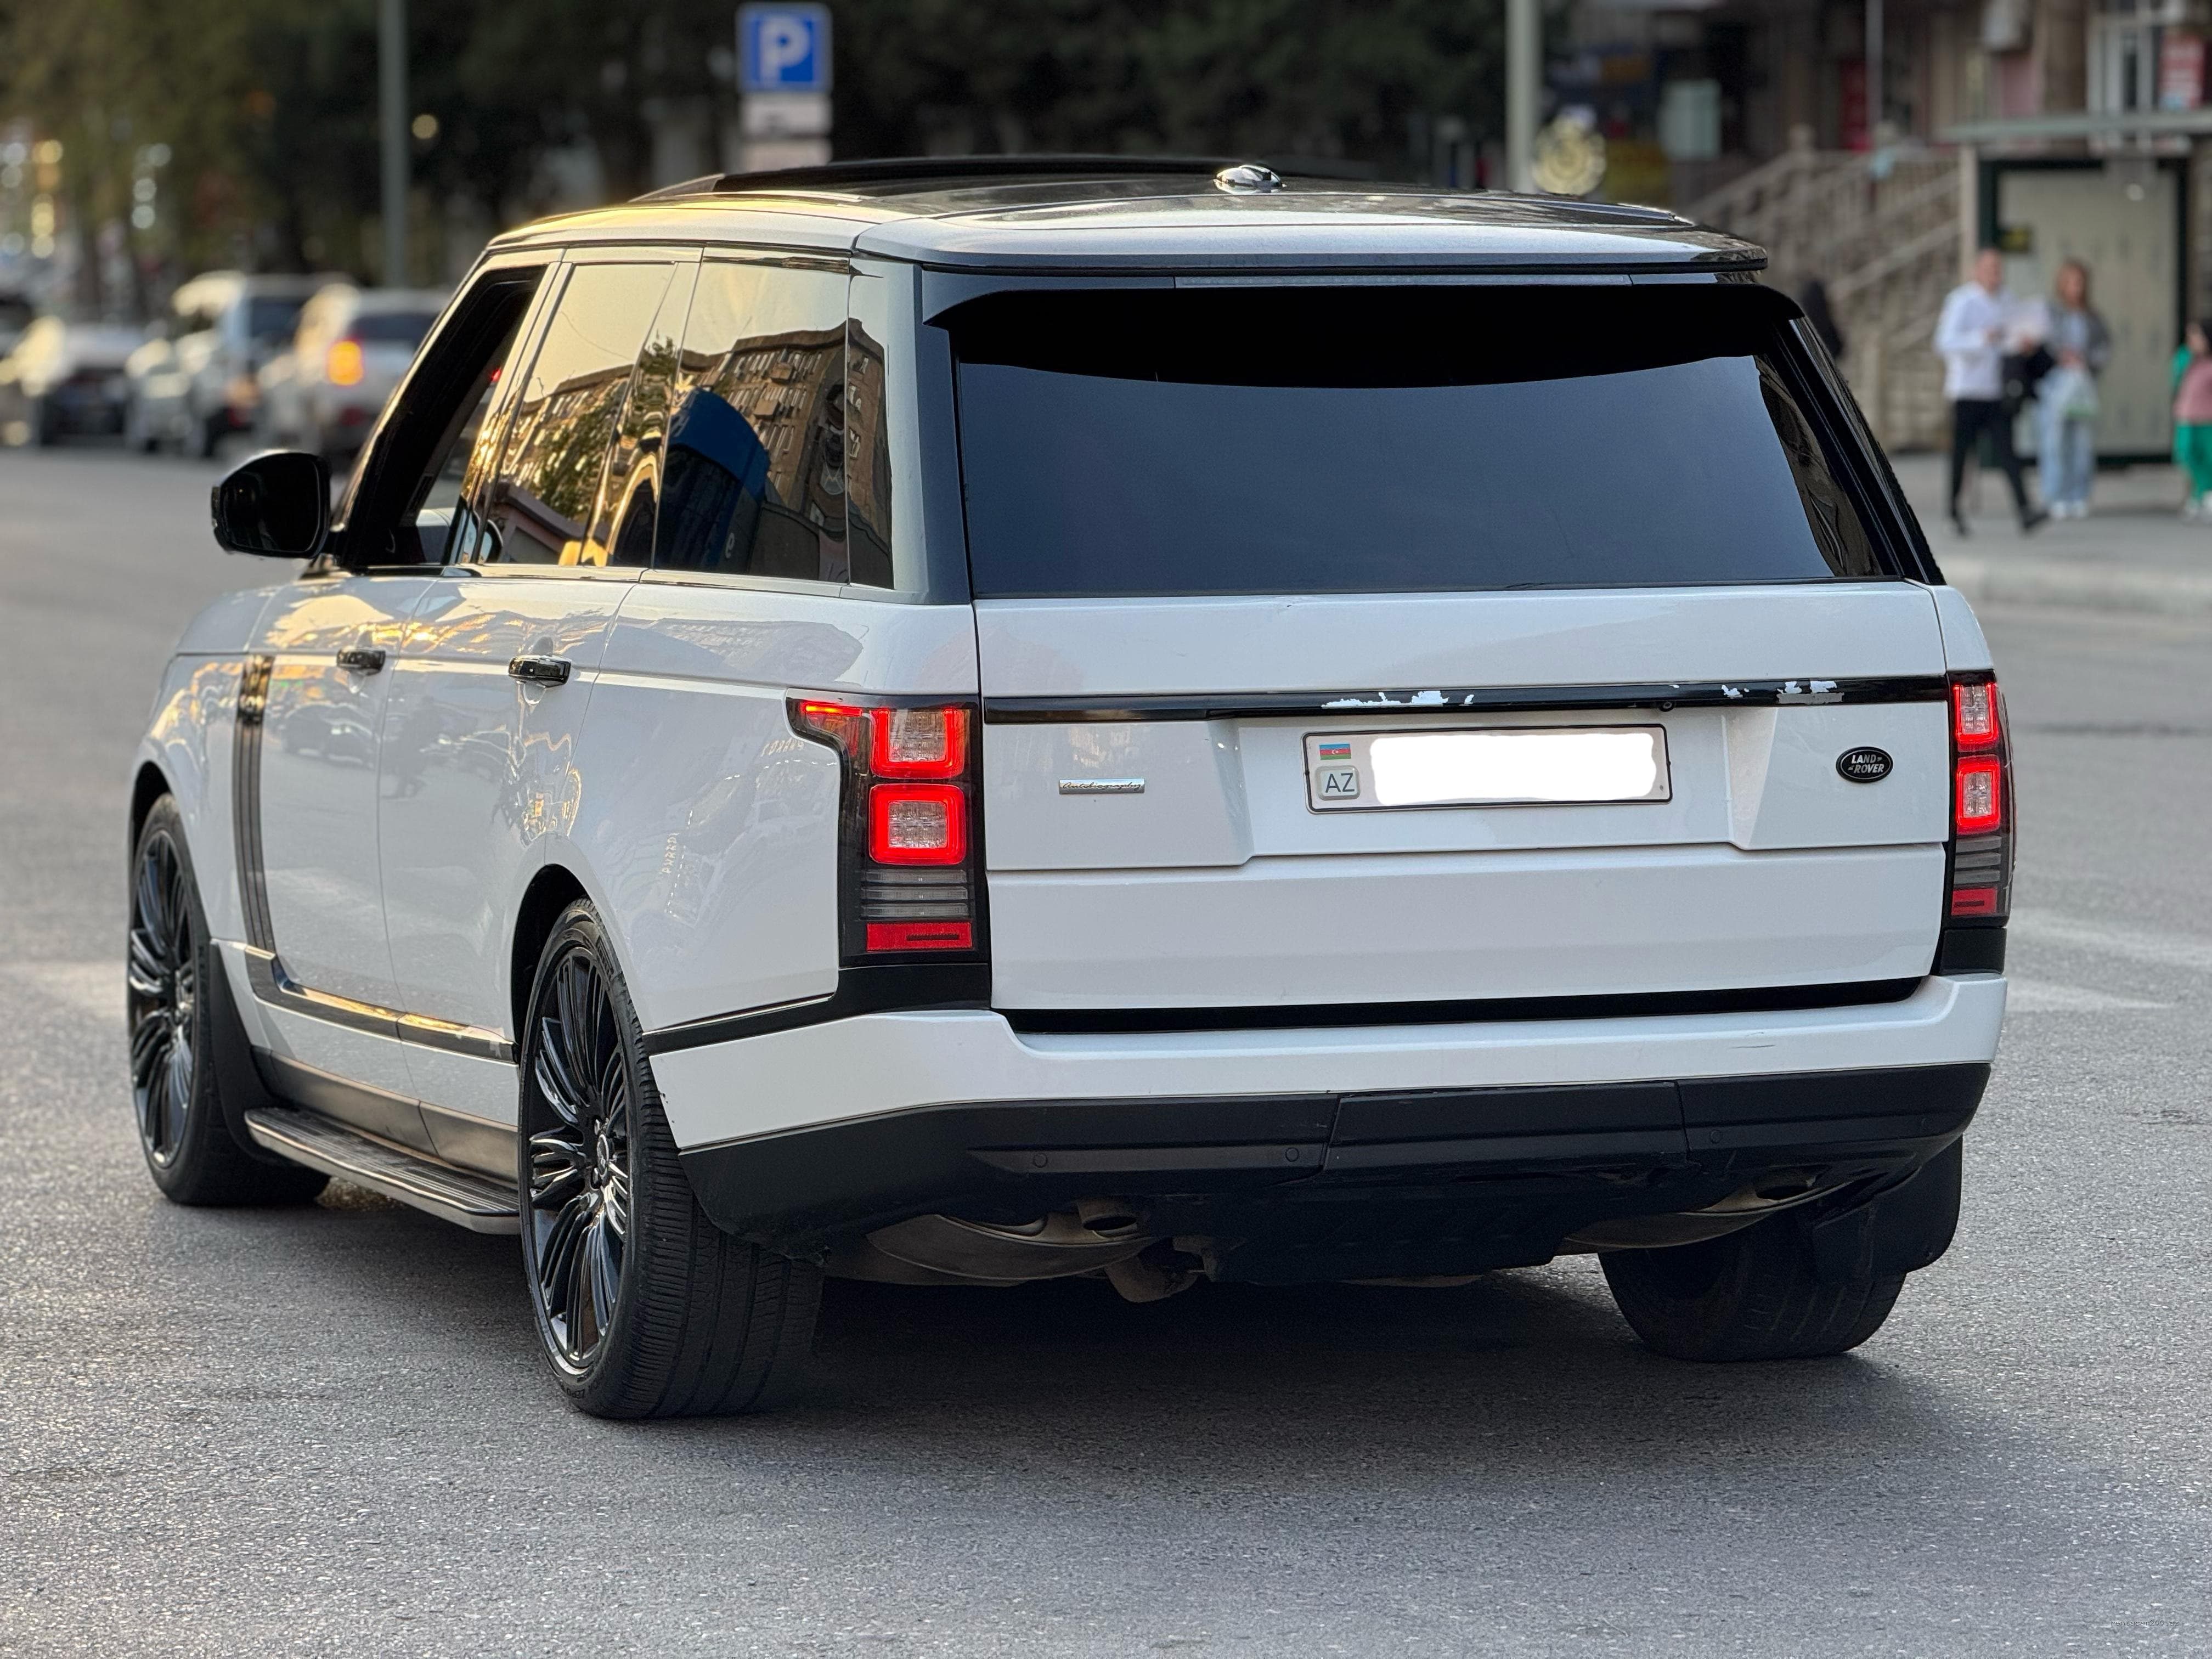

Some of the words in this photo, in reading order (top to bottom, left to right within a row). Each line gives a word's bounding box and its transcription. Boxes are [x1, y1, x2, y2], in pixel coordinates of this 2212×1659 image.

[760, 16, 810, 87] P
[1851, 754, 1876, 764] LAND
[1853, 764, 1884, 774] ROVER
[1062, 781, 1142, 791] Autobiography
[1325, 772, 1355, 793] AZ
